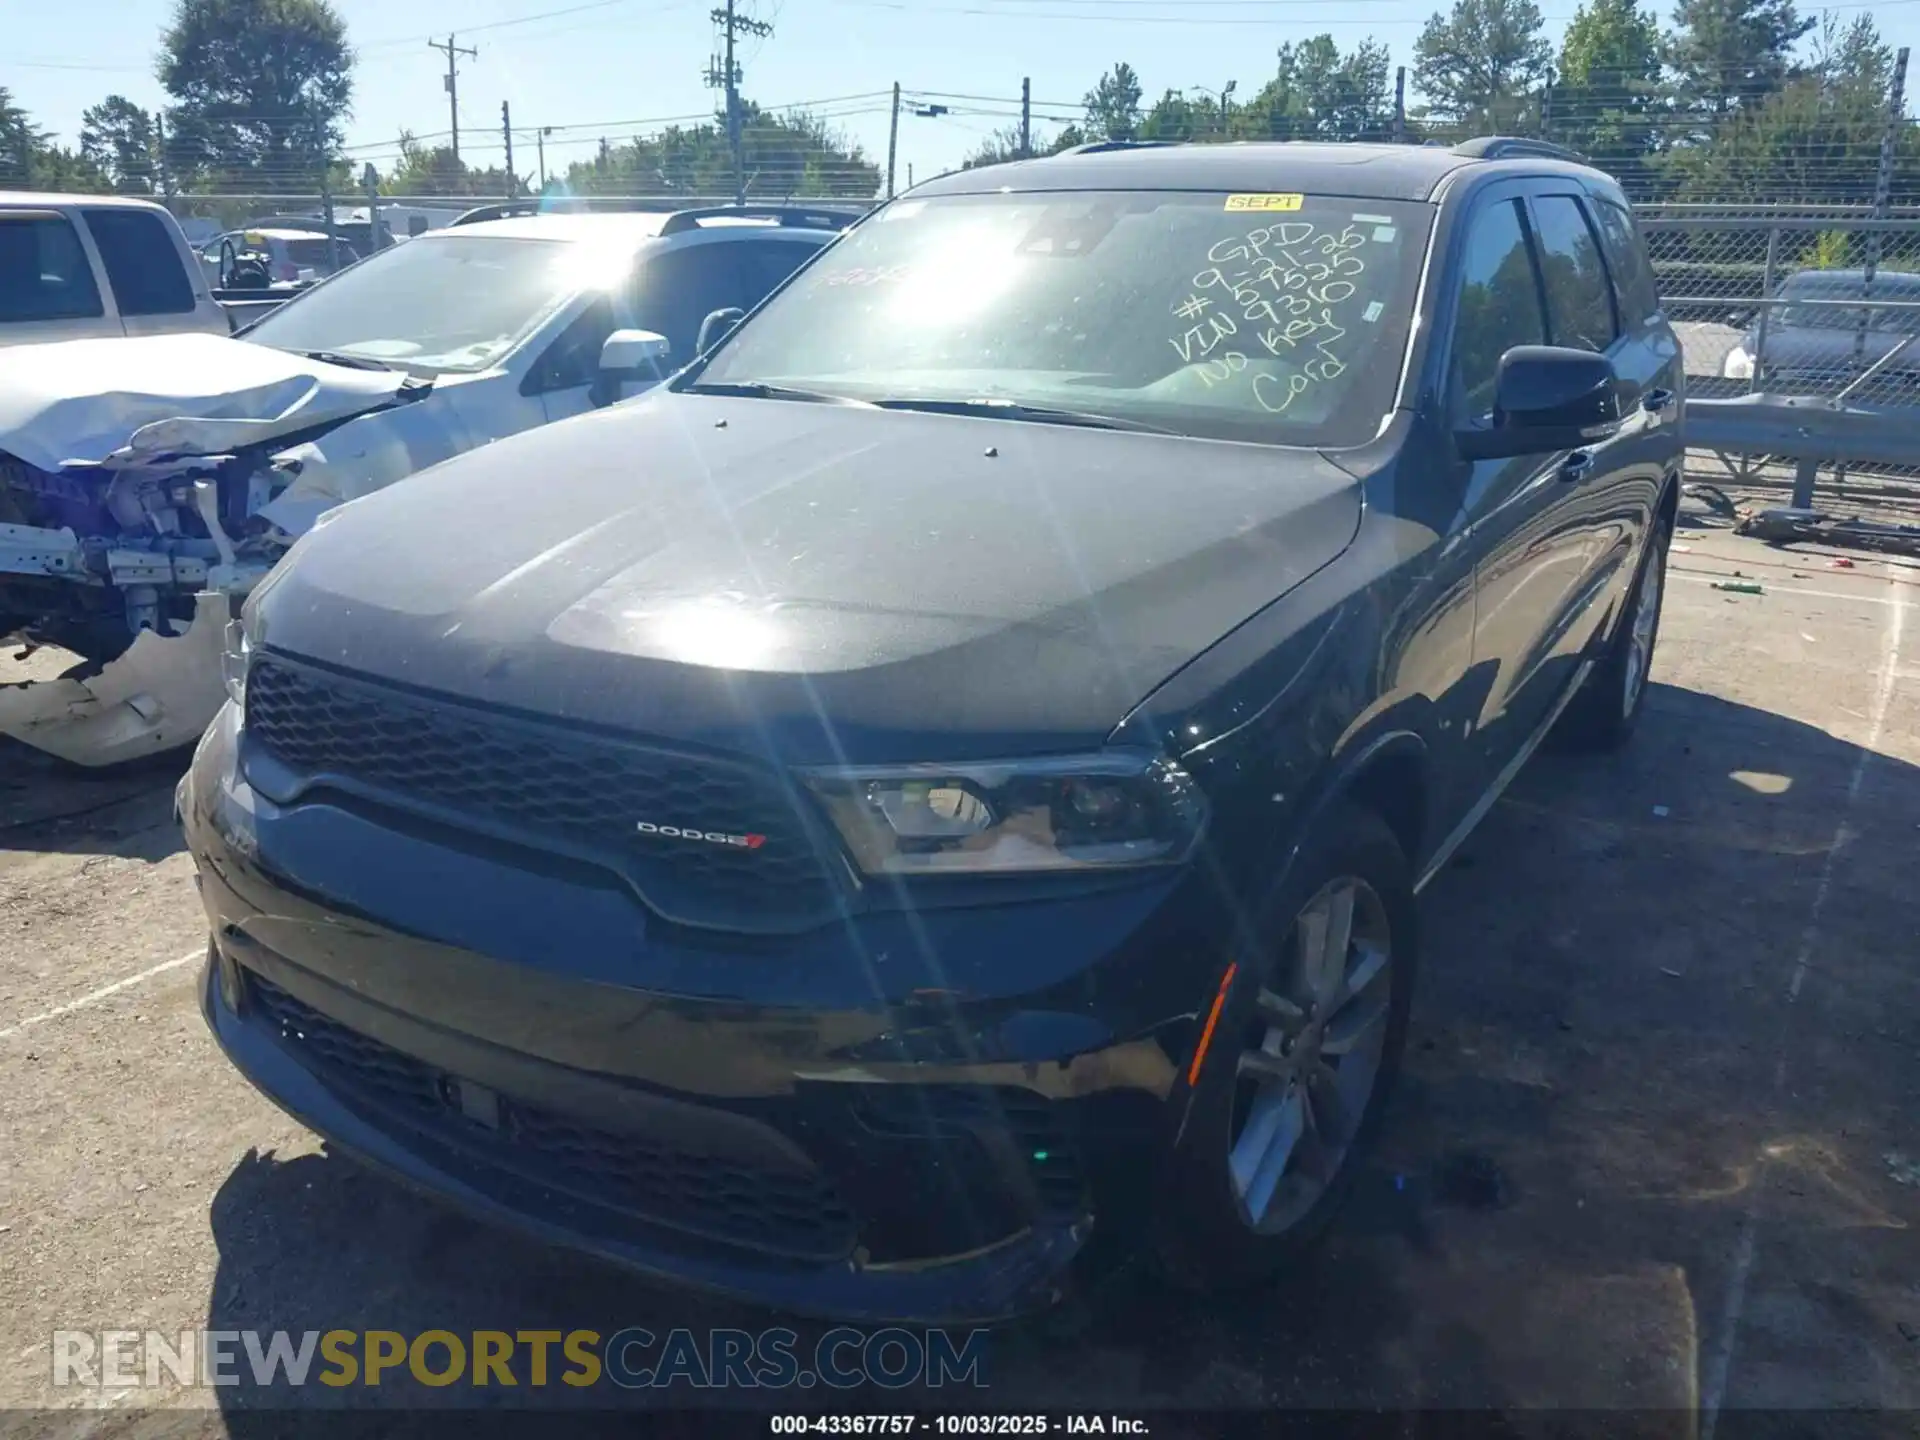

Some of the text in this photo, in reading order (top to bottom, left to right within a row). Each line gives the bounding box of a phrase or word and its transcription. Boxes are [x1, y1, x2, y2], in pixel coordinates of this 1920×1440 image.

[1228, 196, 1301, 208] SEPT
[1208, 222, 1314, 262] GPD
[1172, 294, 1214, 319] #
[1168, 312, 1237, 362] VIN
[637, 821, 750, 846] DODGE
